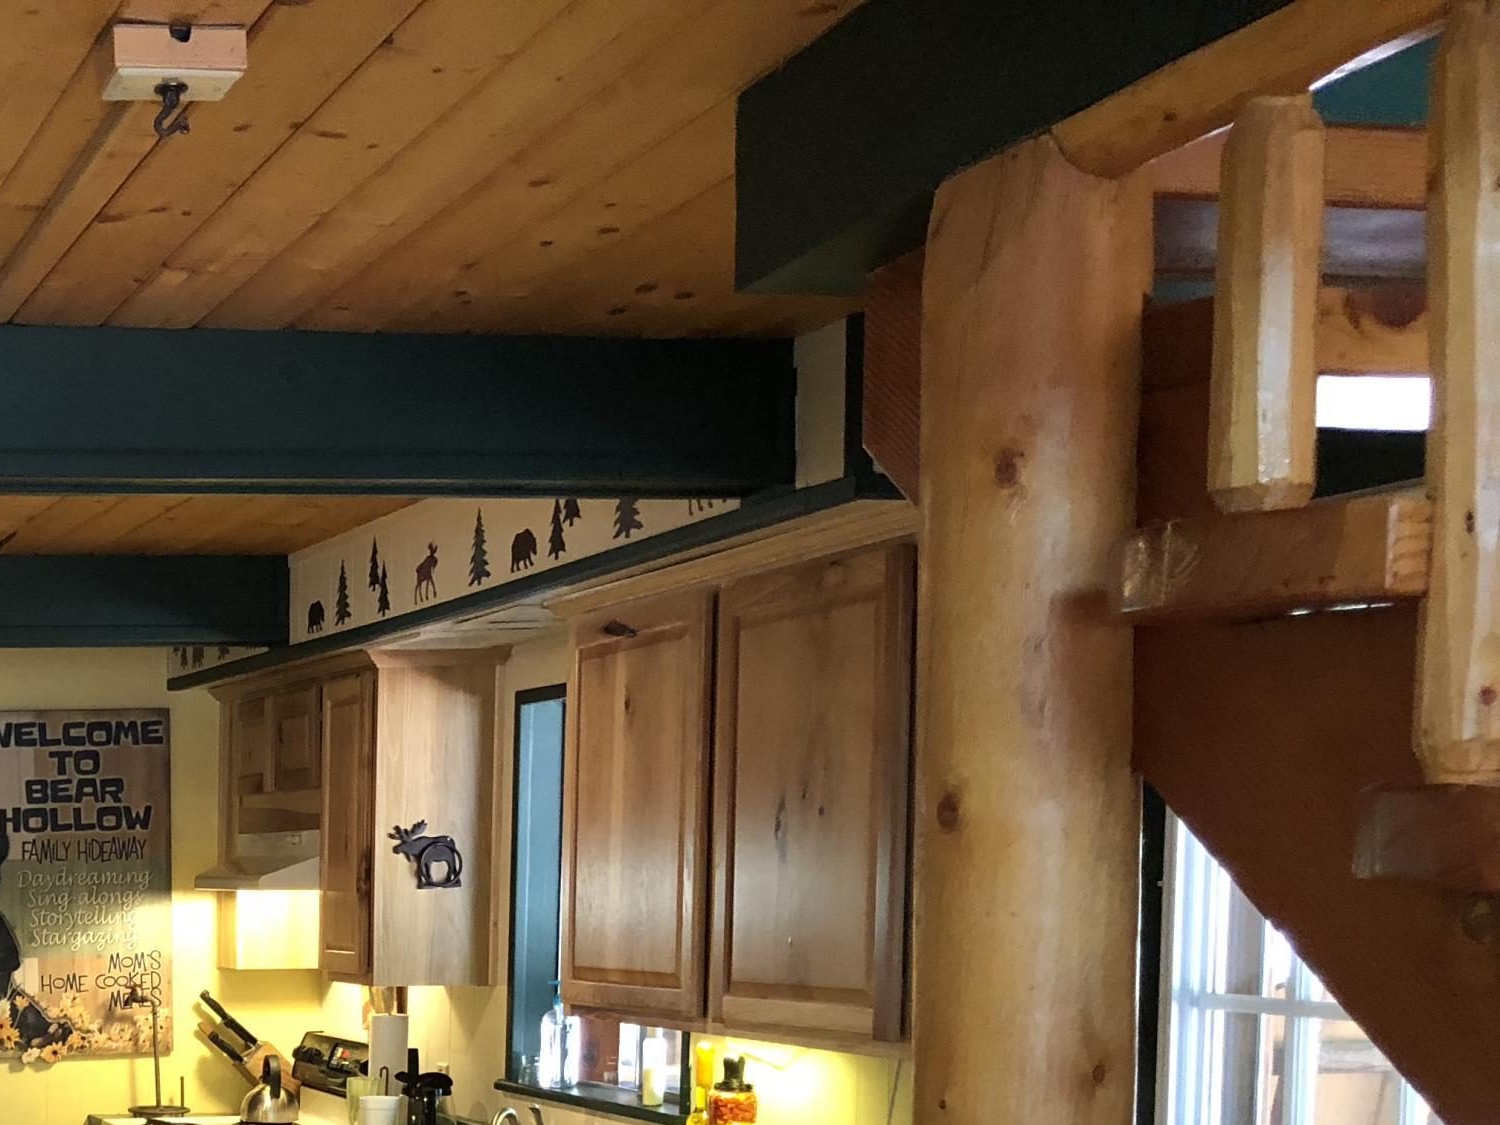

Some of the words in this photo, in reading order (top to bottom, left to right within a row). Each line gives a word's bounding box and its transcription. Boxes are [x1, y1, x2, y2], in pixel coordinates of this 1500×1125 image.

[48, 750, 100, 776] TO
[25, 778, 124, 804] BEAR
[17, 867, 154, 892] Daydreaming
[40, 972, 89, 994] HOME
[94, 971, 162, 990] COOKED
